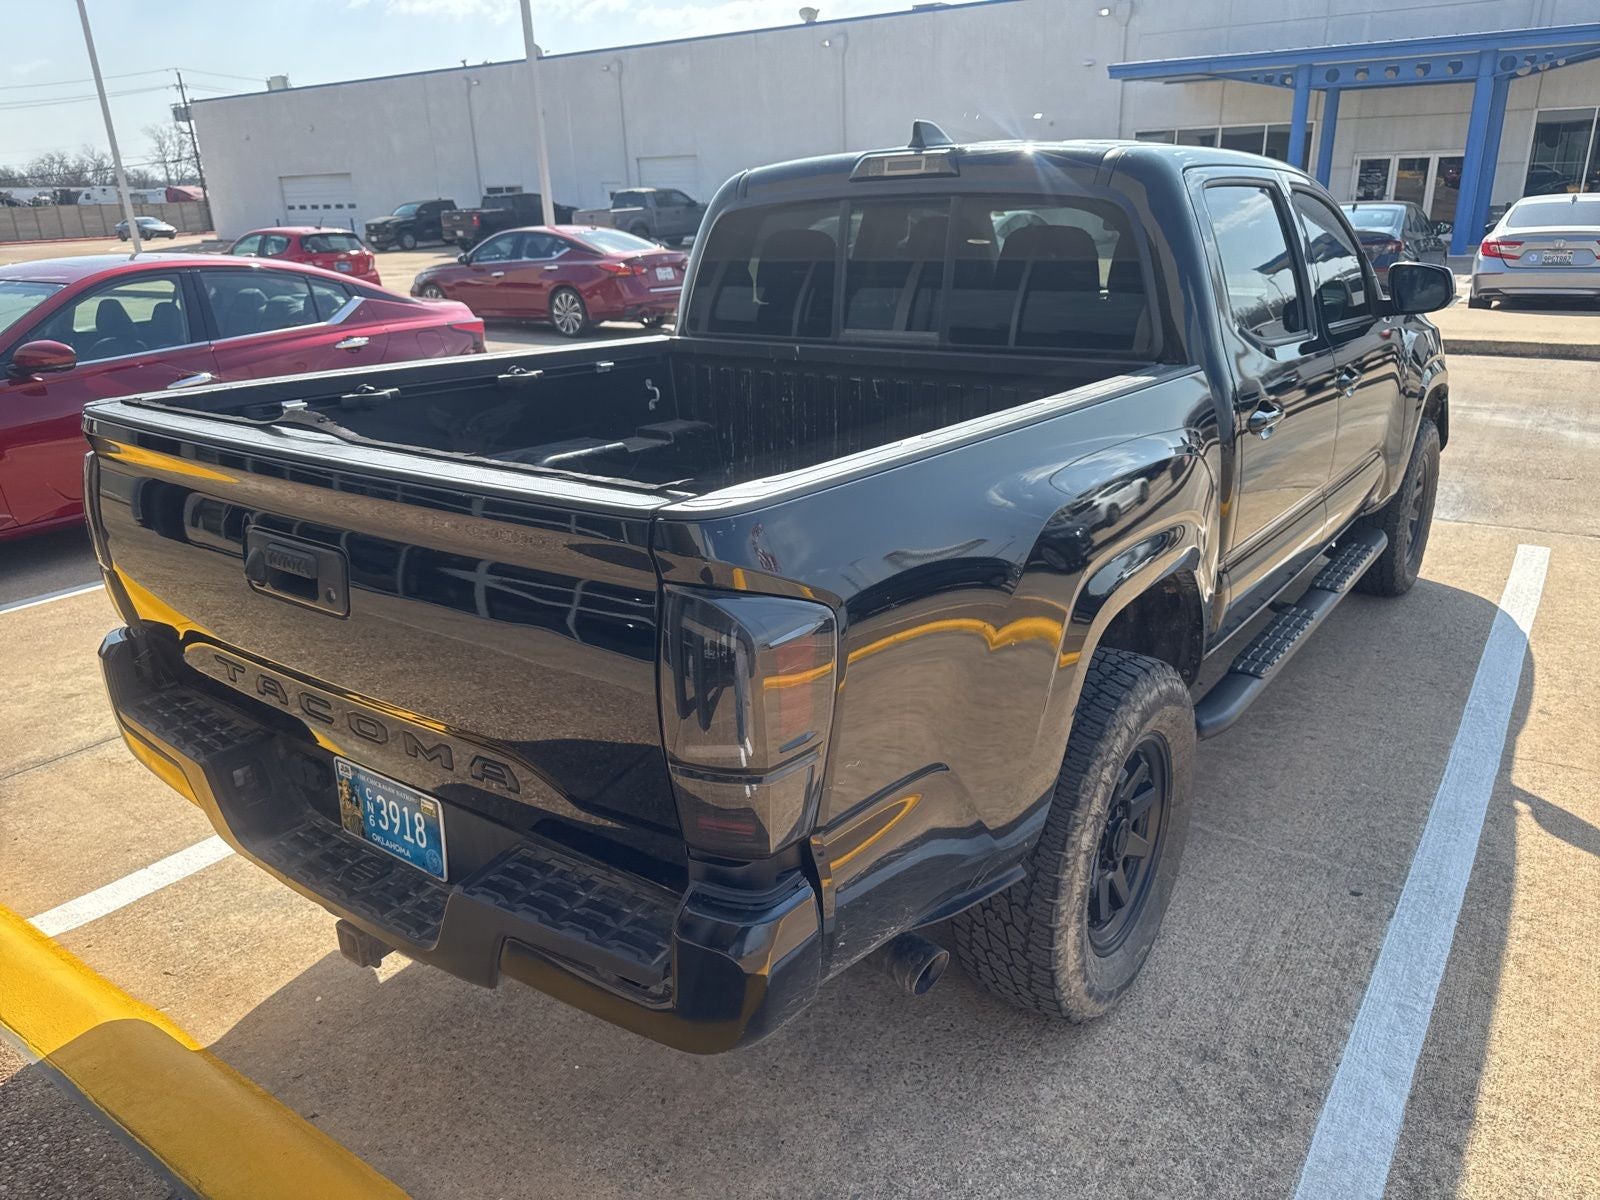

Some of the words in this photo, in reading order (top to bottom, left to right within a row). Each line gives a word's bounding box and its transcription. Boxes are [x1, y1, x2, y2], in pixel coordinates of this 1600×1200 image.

[214, 654, 522, 795] TACOMA
[372, 833, 411, 858] OKLAHOMA
[376, 795, 427, 849] 3918
